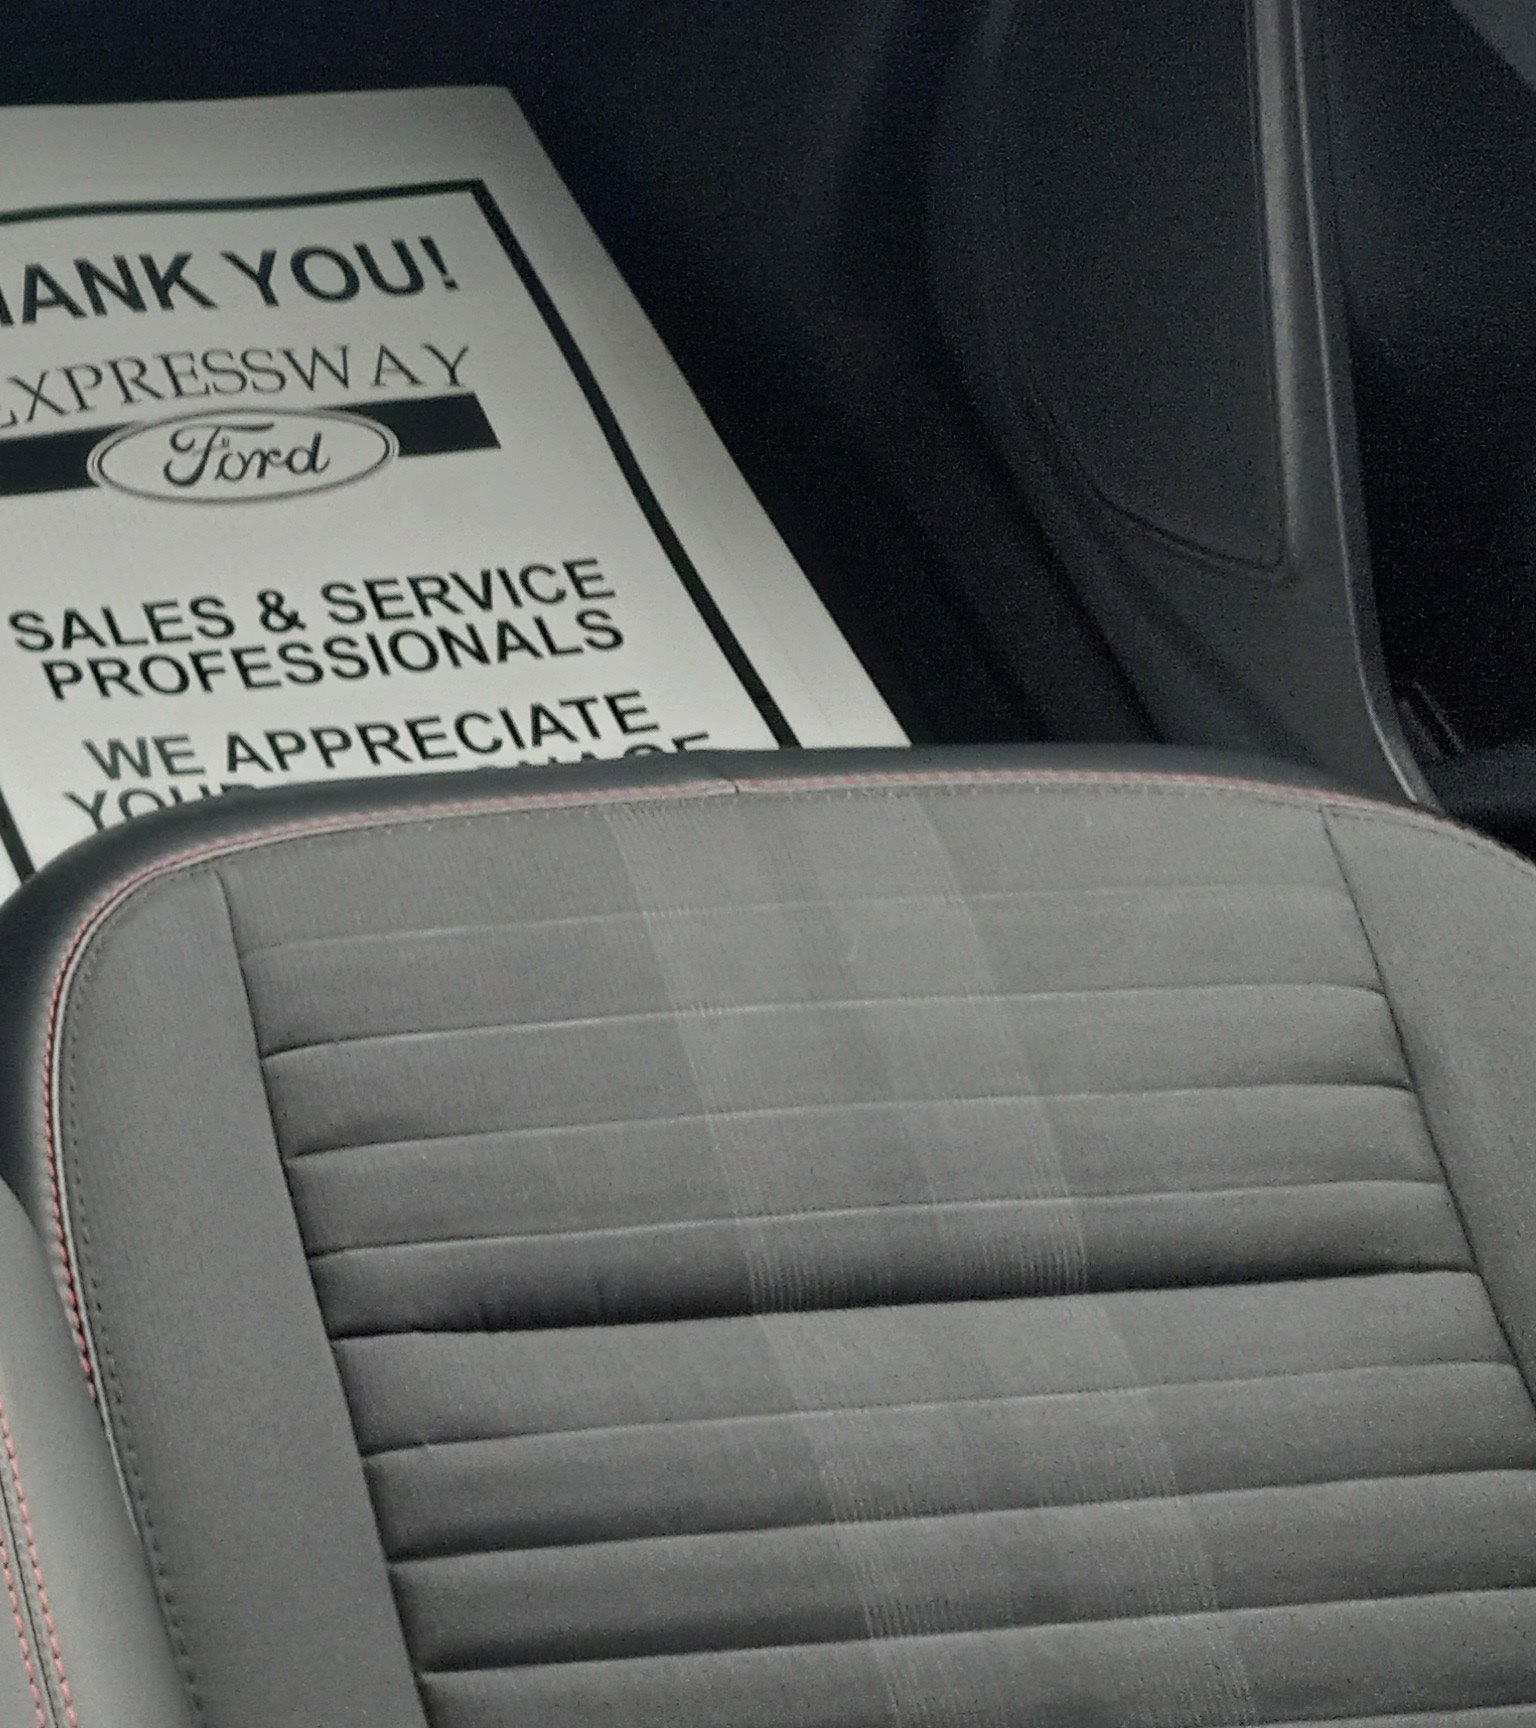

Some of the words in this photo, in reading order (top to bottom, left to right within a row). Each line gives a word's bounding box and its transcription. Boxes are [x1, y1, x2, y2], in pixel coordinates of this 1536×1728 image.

[221, 235, 462, 308] YOU!
[162, 422, 330, 489] Ford
[7, 593, 237, 654] SALES
[256, 587, 307, 634] &
[320, 556, 616, 627] SERVICE
[40, 608, 625, 702] PROFESSIONALS
[82, 732, 207, 782] WE
[226, 688, 661, 773] APPRECIATE
